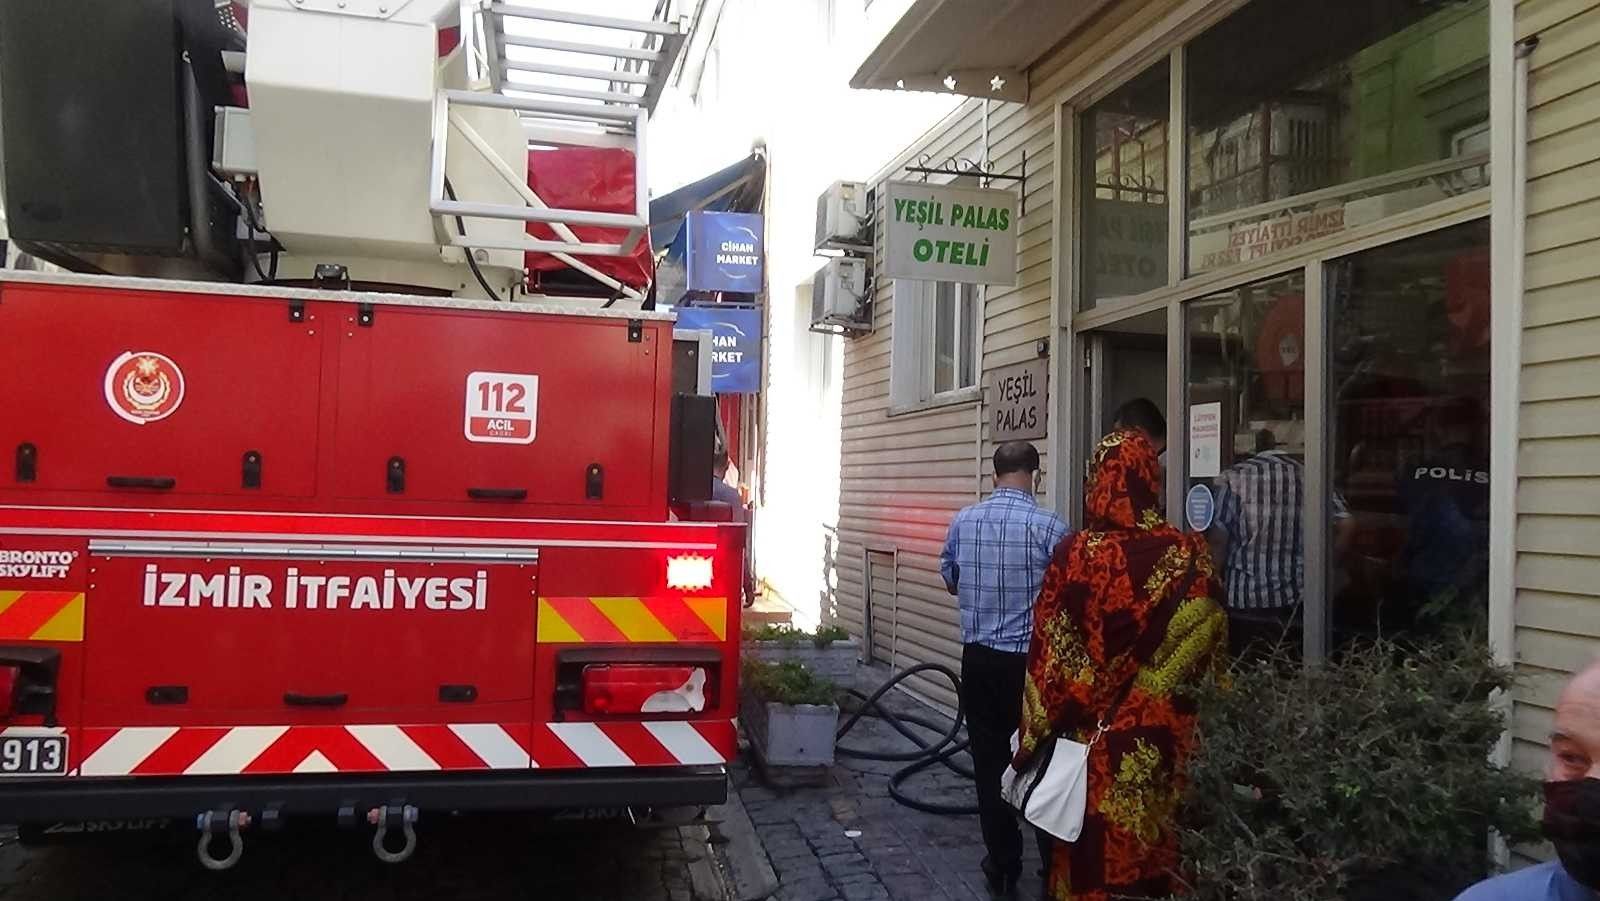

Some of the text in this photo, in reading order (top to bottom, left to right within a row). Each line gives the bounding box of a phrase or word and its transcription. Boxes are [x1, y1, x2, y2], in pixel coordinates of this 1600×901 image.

[894, 195, 1010, 231] YEŞİL PALAS
[721, 240, 754, 252] CİHAN
[913, 238, 990, 266] OTELİ
[716, 254, 759, 265] MARKET
[712, 335, 737, 347] HAN
[711, 351, 743, 363] RKET
[478, 381, 526, 413] 112
[998, 369, 1037, 404] YEŞİL
[996, 406, 1037, 431] PALAS
[0, 564, 70, 578] SKYLIFT
[143, 564, 488, 610] İZMİR İTFAİYESİ
[2, 738, 61, 771] 913
